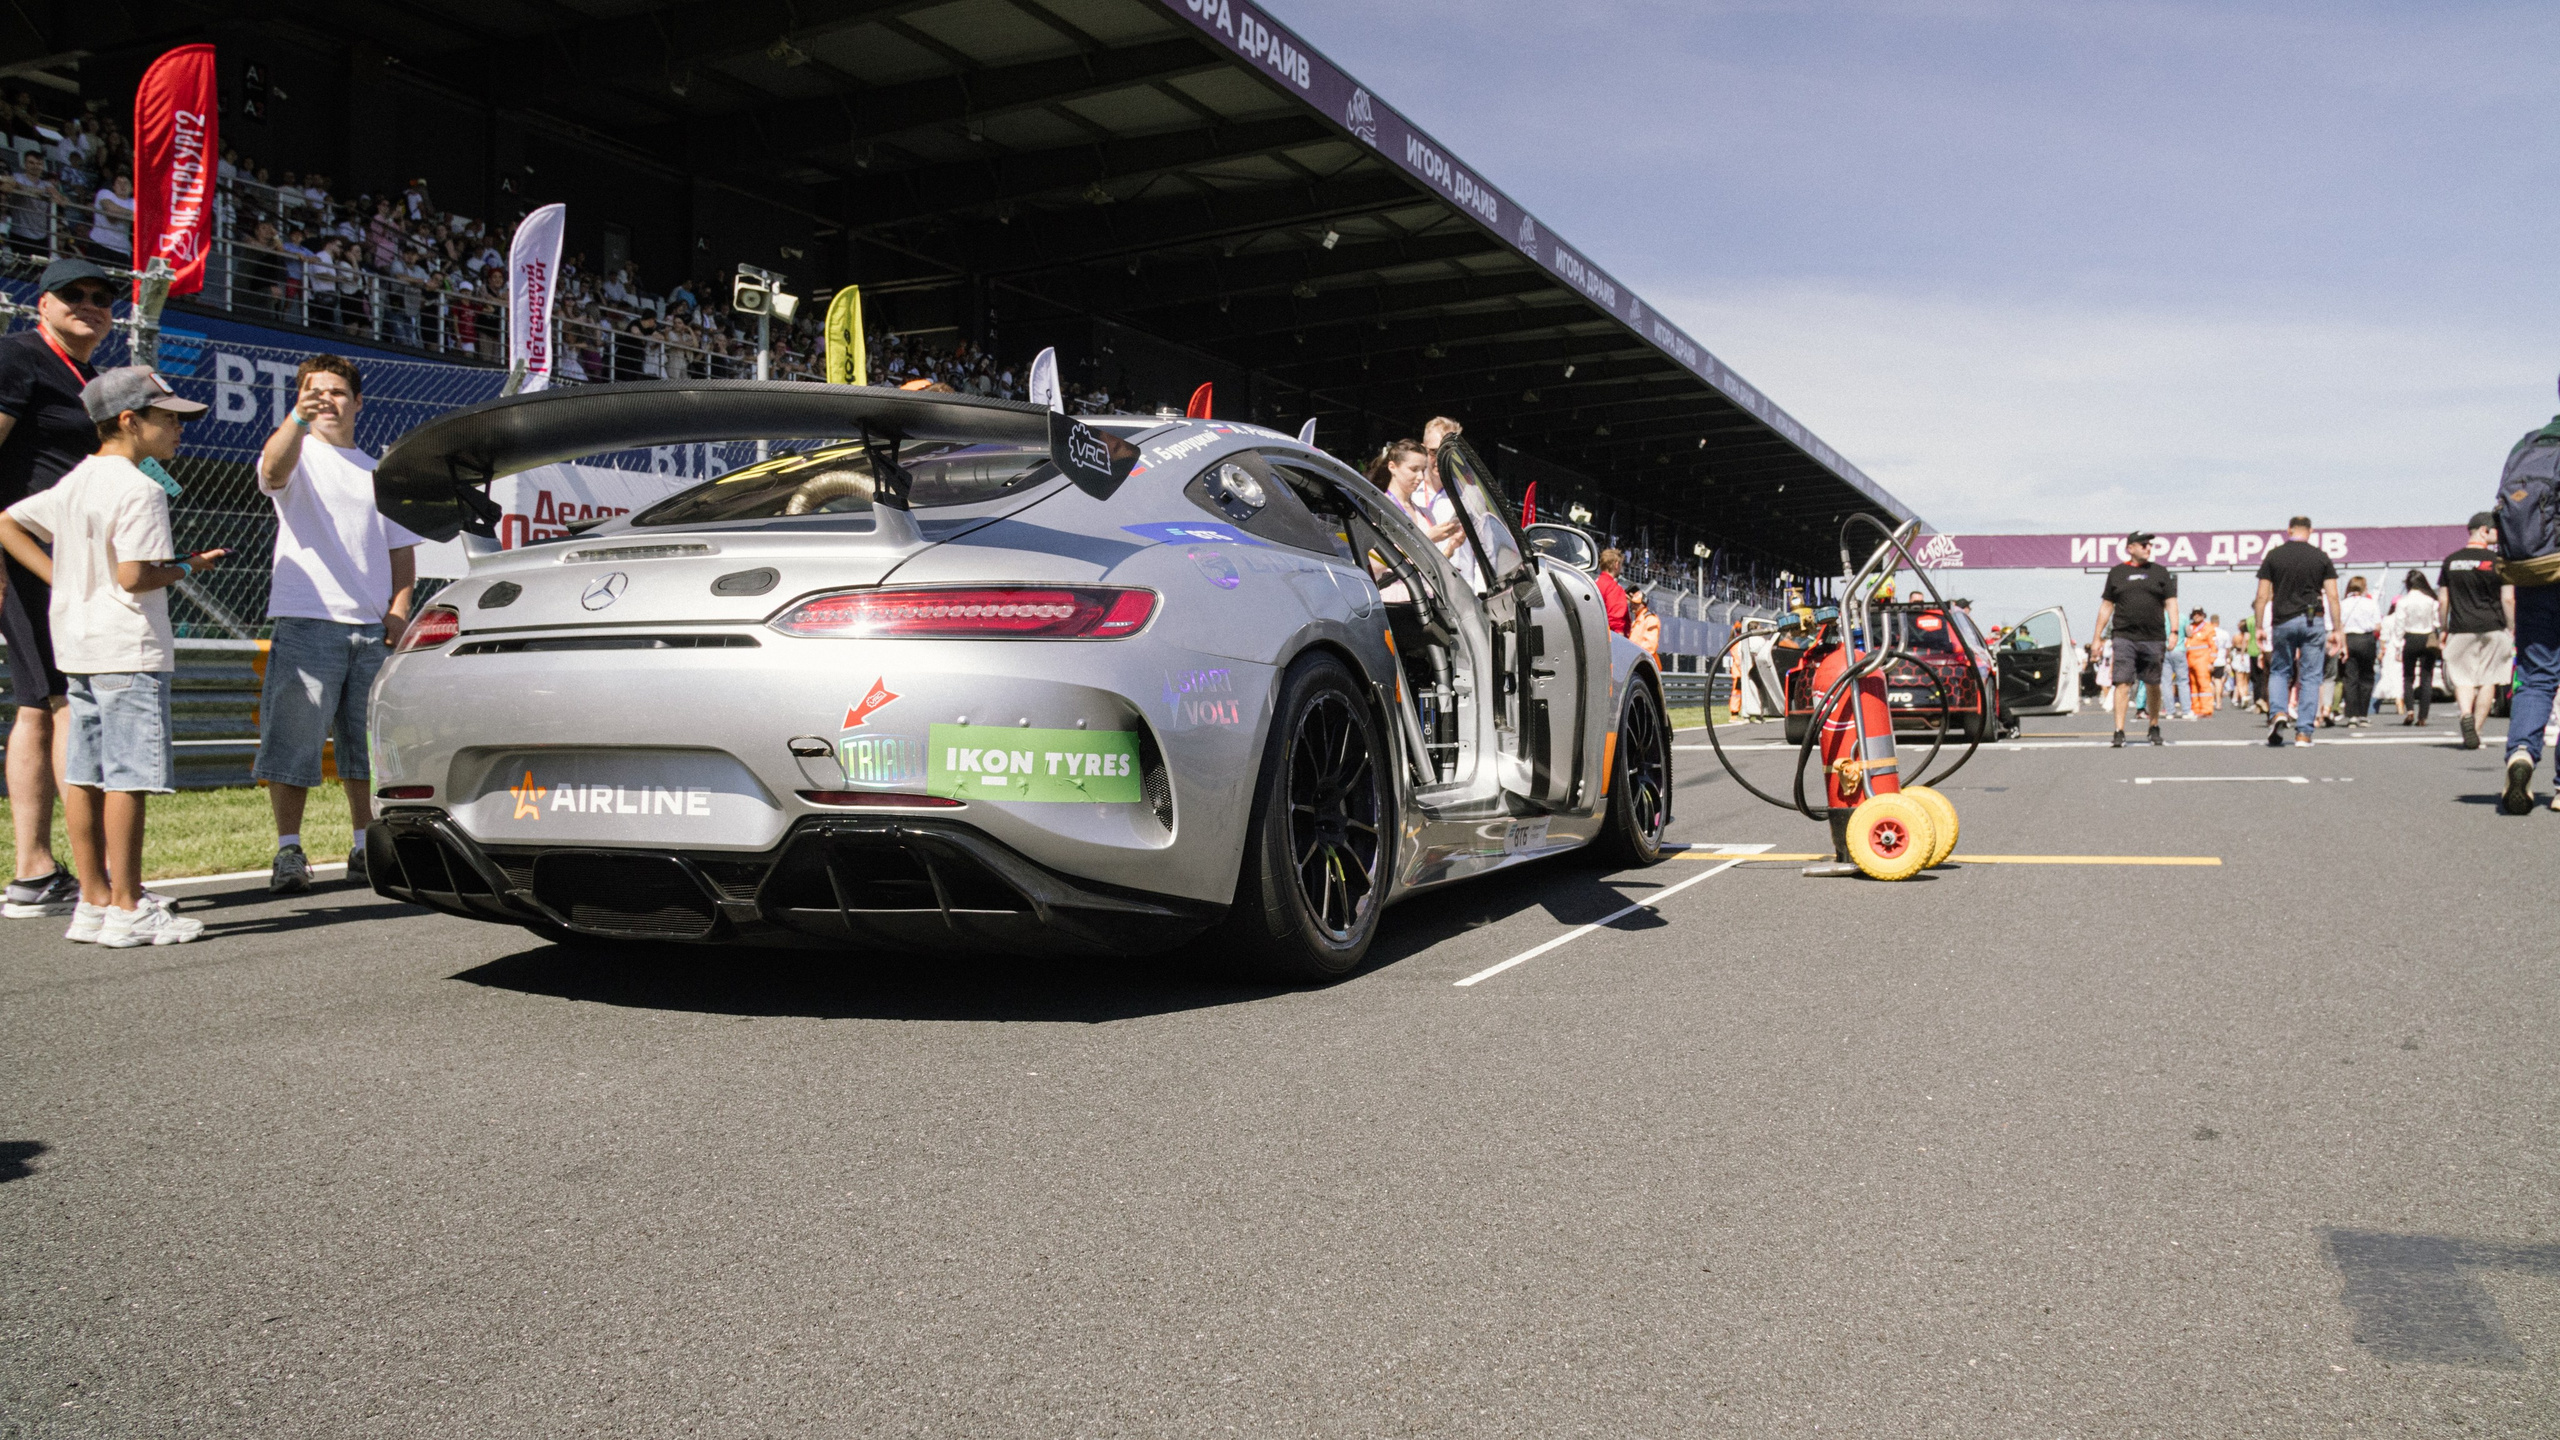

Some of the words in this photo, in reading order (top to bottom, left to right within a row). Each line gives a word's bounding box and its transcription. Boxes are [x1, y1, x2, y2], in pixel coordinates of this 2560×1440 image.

[1239, 12, 1310, 90] ДРАЙВ
[1406, 134, 1452, 191] ИГОРА
[1454, 170, 1498, 223] ДРАЙВ
[1555, 246, 1586, 288] ИГОРА
[215, 352, 299, 429] ВТ
[1075, 439, 1106, 466] VRC
[1176, 668, 1233, 693] START
[1184, 699, 1240, 725] VOLT
[946, 747, 1034, 774] IKON
[1045, 752, 1130, 777] TYRES
[551, 782, 712, 816] AIRLINE
